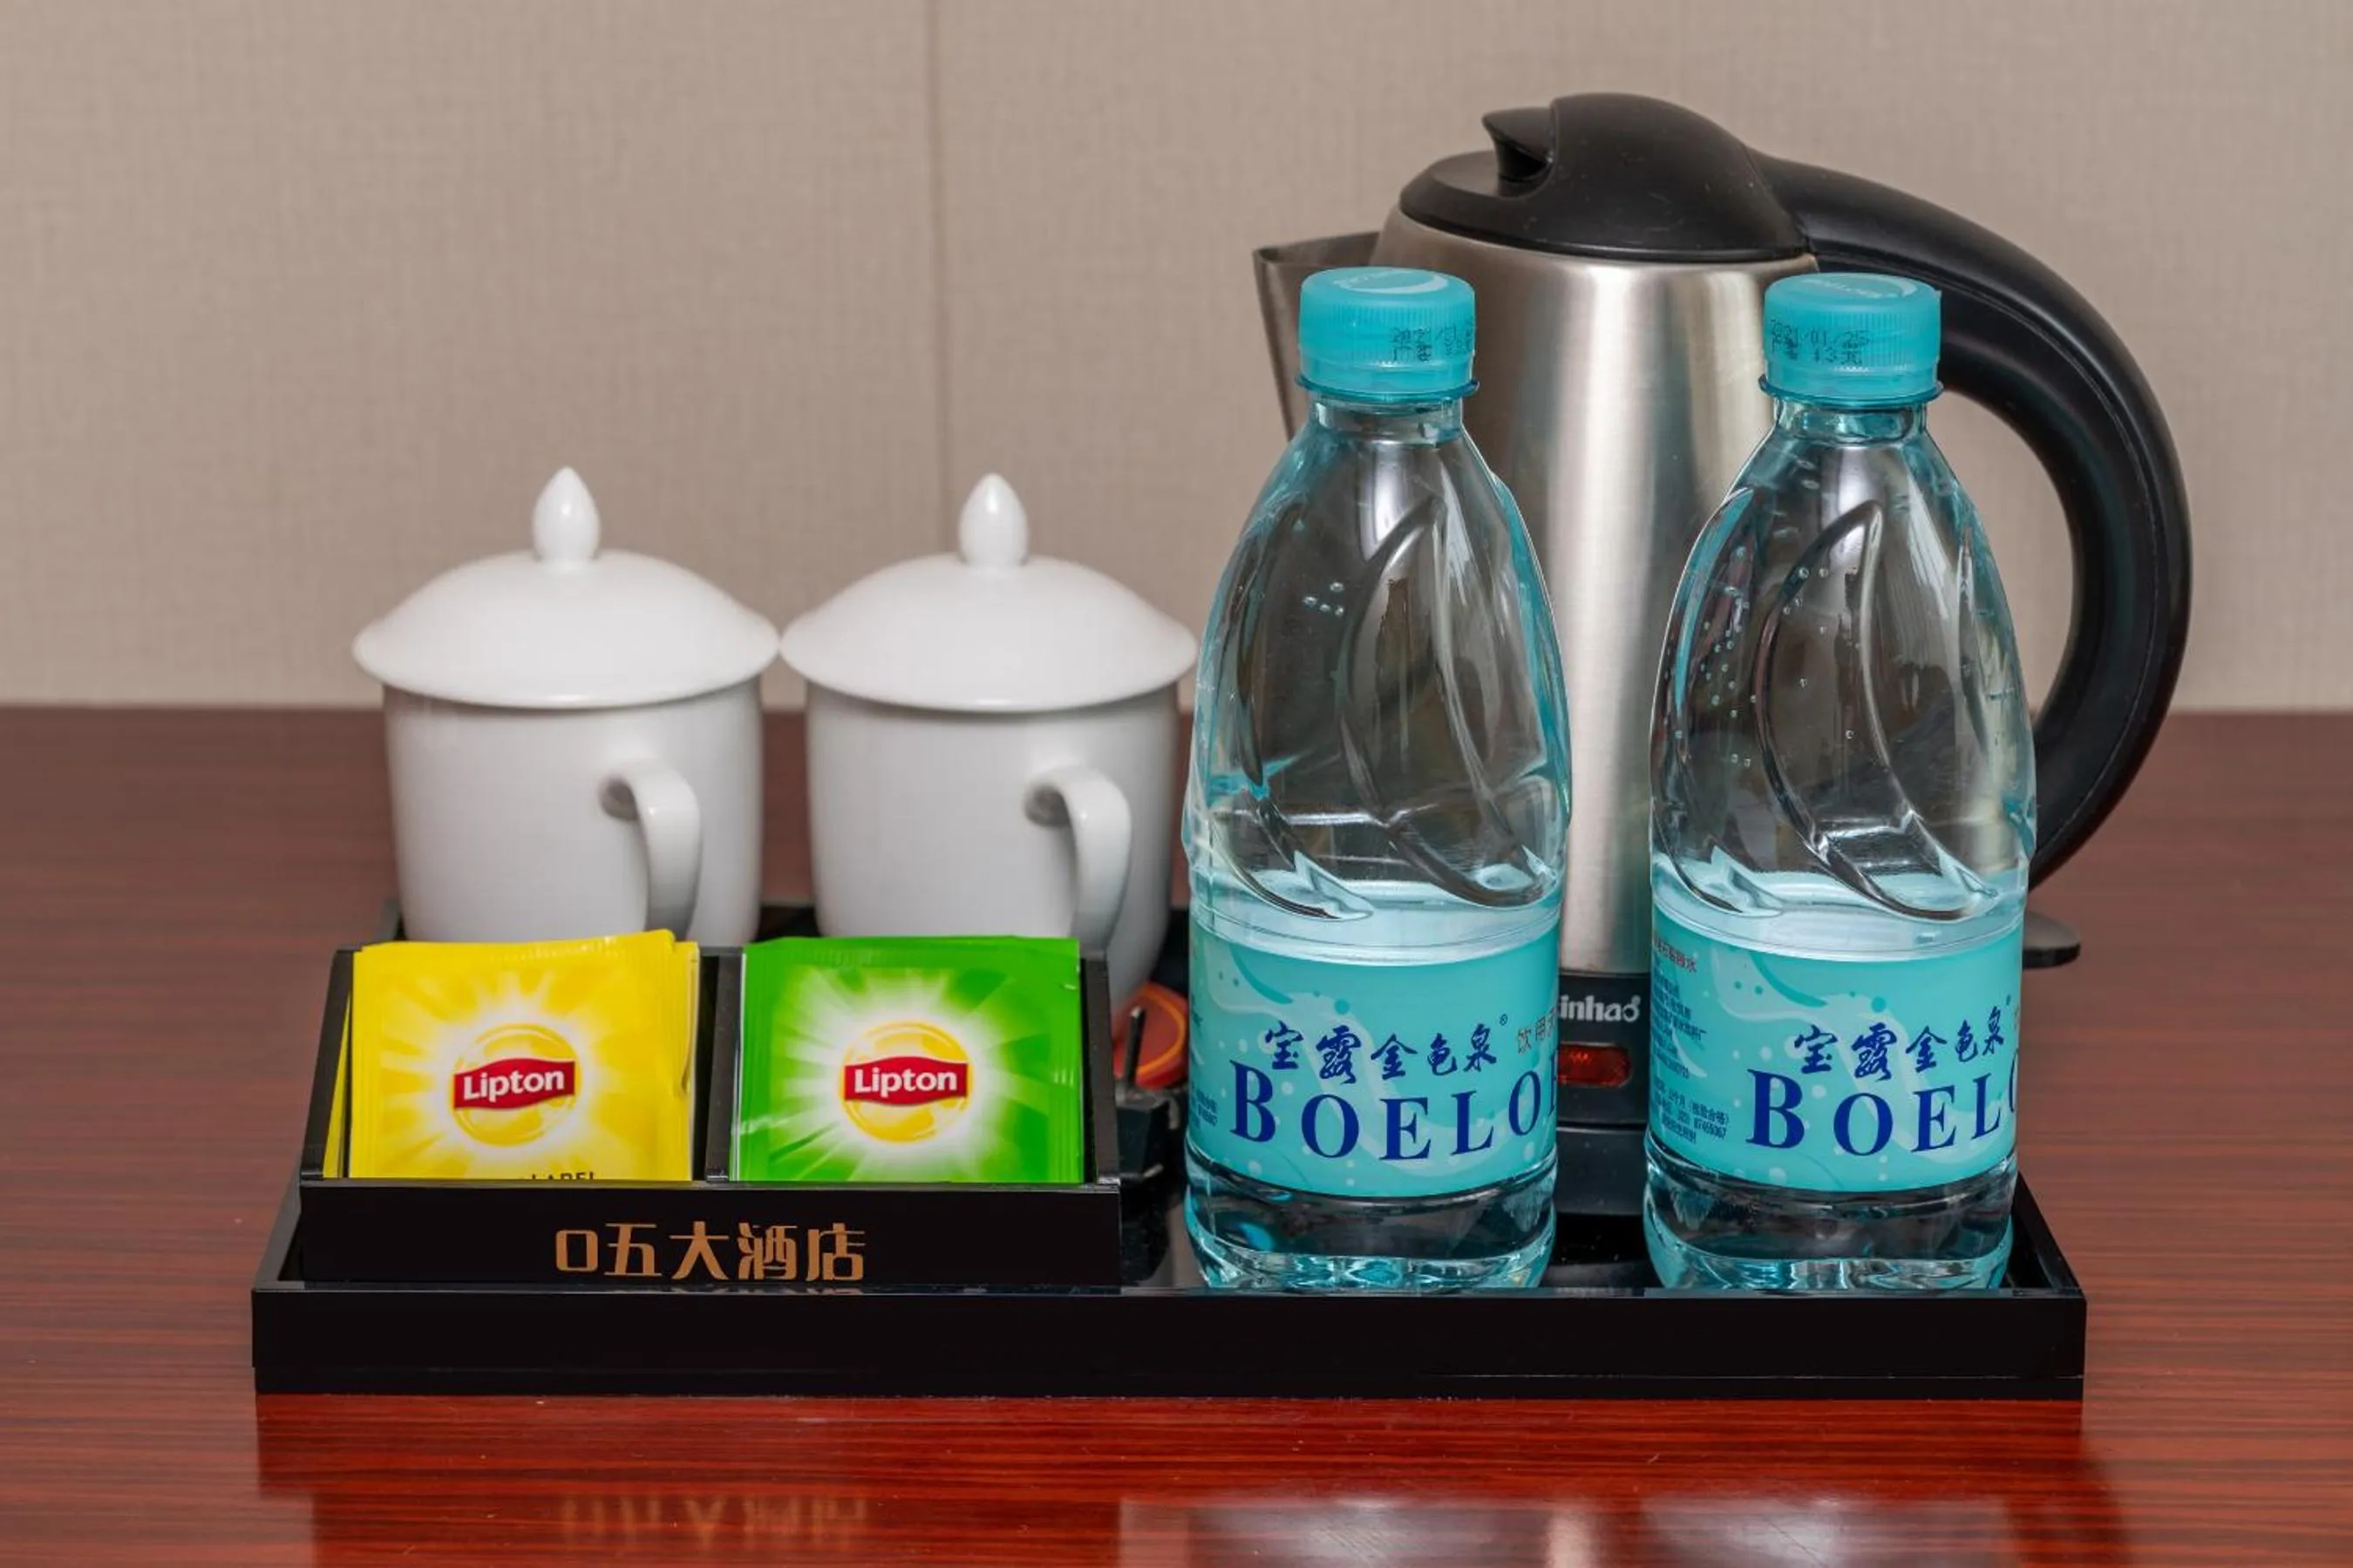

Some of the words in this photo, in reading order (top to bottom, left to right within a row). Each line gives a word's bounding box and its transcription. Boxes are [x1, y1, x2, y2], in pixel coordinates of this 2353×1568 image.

[1559, 995, 1641, 1022] inhao
[1265, 1021, 1496, 1084] 宝露金色泉
[463, 1069, 564, 1103] Lipton
[853, 1066, 958, 1097] Lipton
